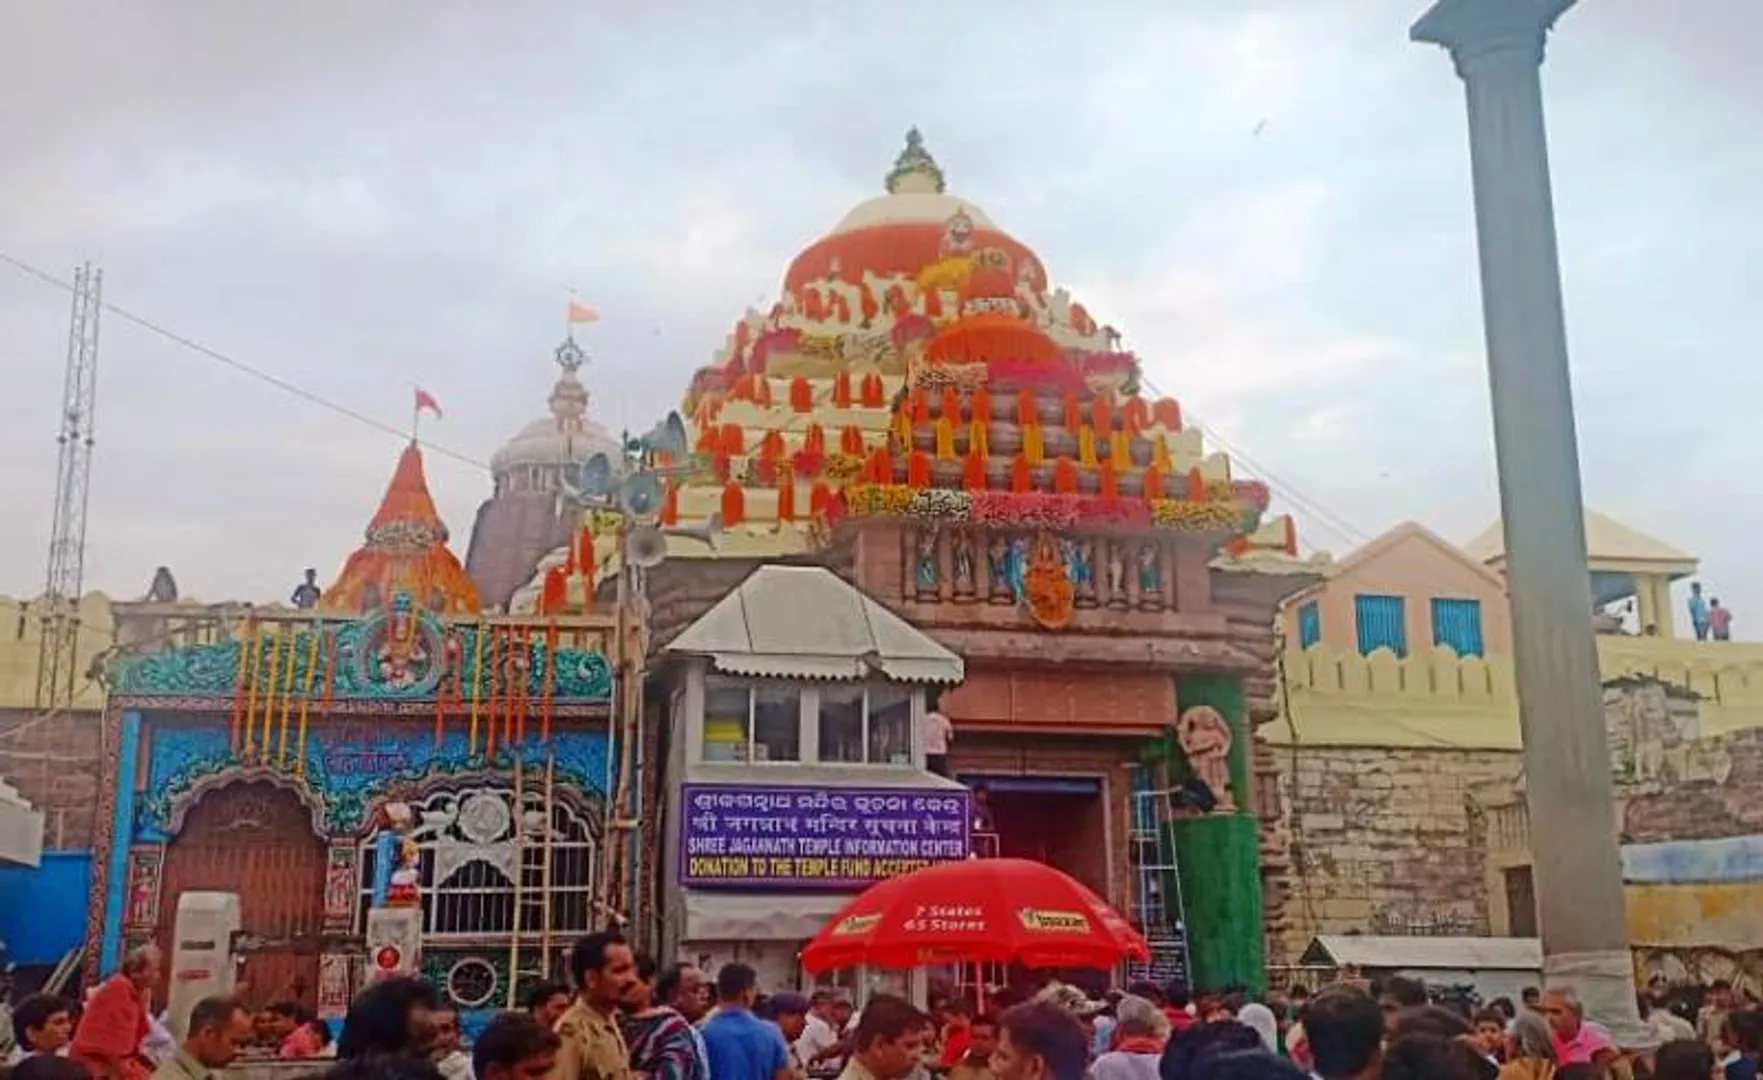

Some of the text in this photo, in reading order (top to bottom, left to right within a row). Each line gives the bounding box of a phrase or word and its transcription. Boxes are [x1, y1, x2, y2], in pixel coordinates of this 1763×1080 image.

[688, 838, 963, 857] SHREE JAGANNATH TEMPLE INFORMATION CENTER
[690, 857, 748, 877] DONATION
[751, 857, 767, 877] TO
[770, 857, 793, 877] THE
[794, 857, 839, 877] TEMPLE
[842, 858, 871, 877] FUND
[929, 905, 983, 917] States
[931, 919, 988, 932] Stores
